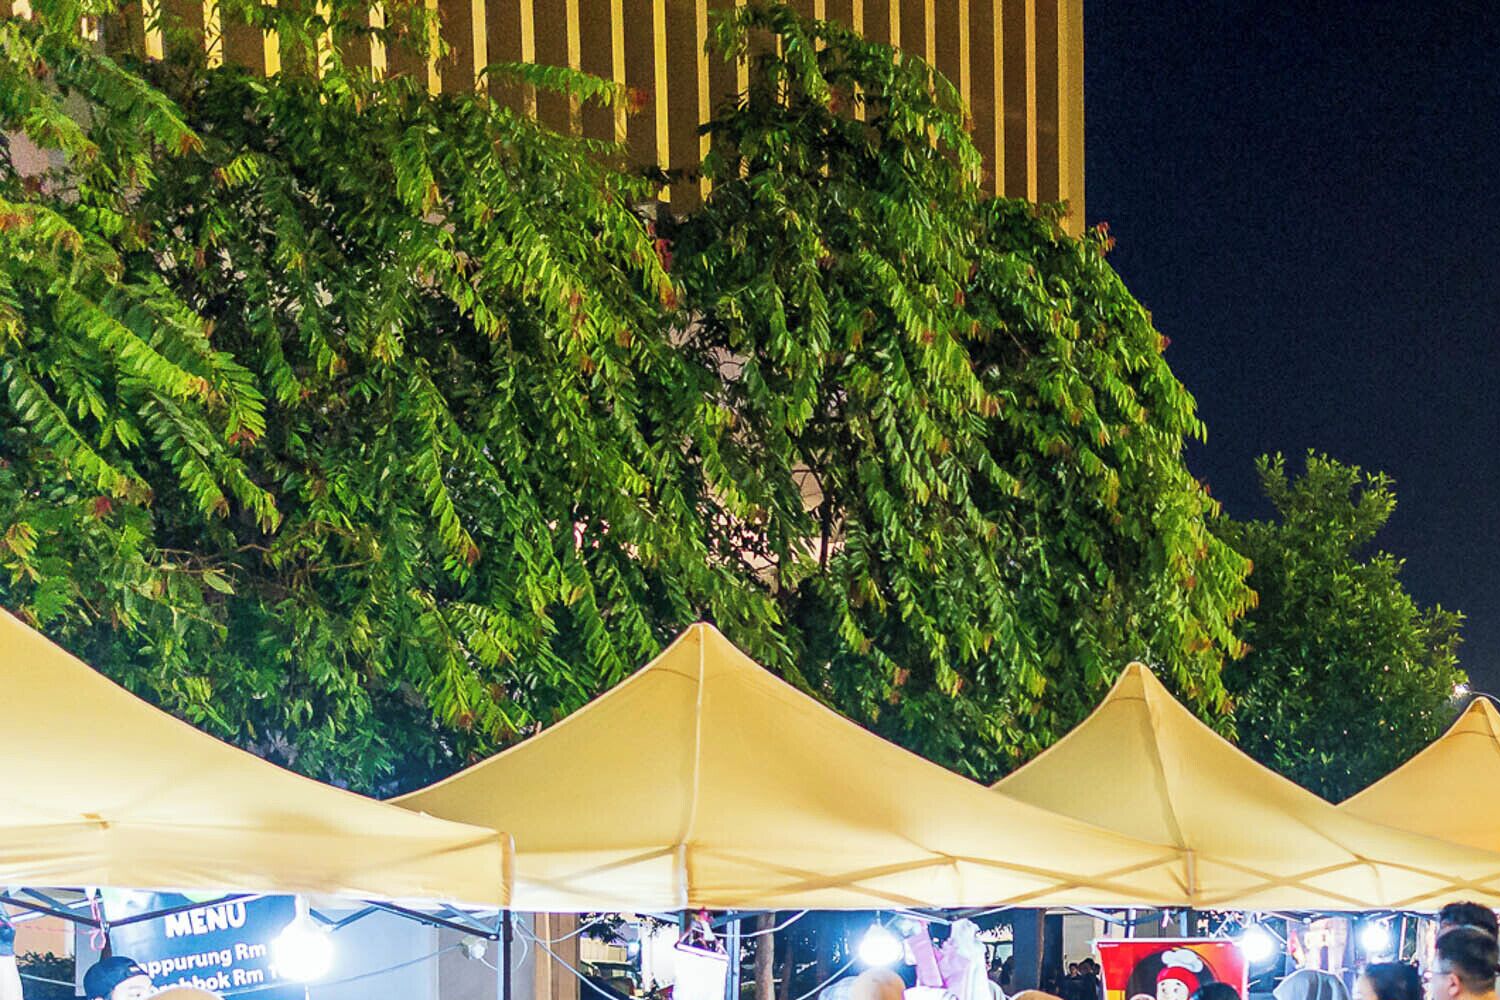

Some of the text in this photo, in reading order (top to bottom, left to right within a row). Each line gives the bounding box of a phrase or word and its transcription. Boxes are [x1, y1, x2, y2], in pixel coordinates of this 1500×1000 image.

[164, 902, 247, 938] MENU
[234, 943, 267, 961] Rm
[232, 969, 264, 986] Rm
